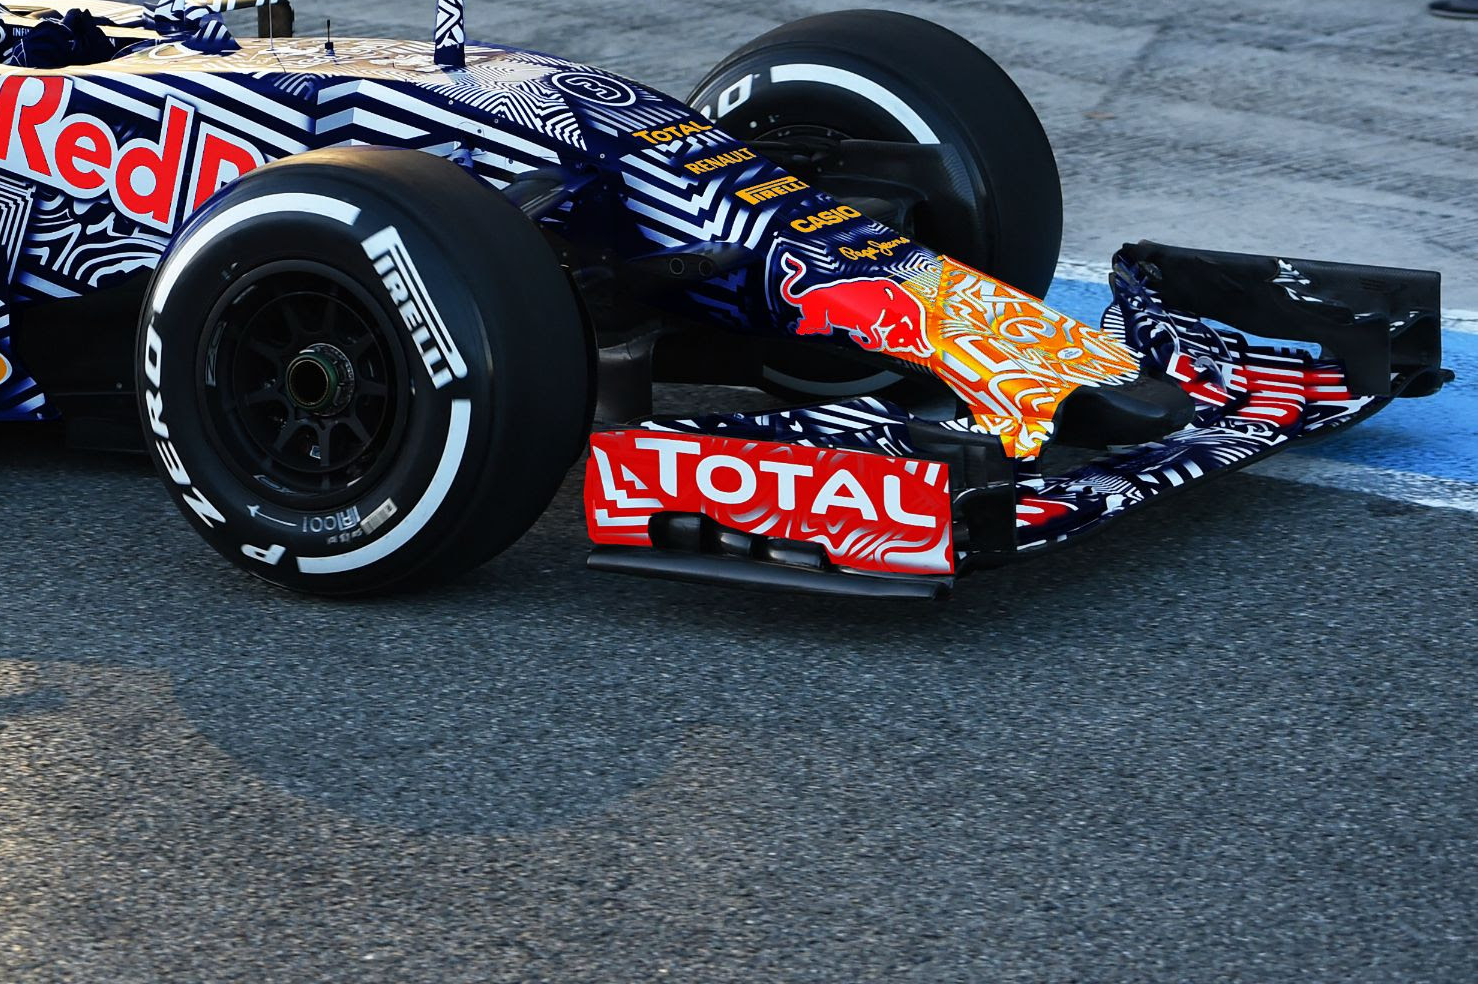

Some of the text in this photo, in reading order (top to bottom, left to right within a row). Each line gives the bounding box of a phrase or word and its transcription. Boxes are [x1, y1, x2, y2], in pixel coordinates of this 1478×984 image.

[684, 147, 757, 175] RENAULT
[735, 175, 811, 206] PIRELLI
[790, 205, 862, 233] CASIO
[361, 225, 468, 390] PIRELLI
[145, 324, 226, 528] ZERO
[635, 437, 937, 529] TOTAL
[241, 544, 286, 565] P
